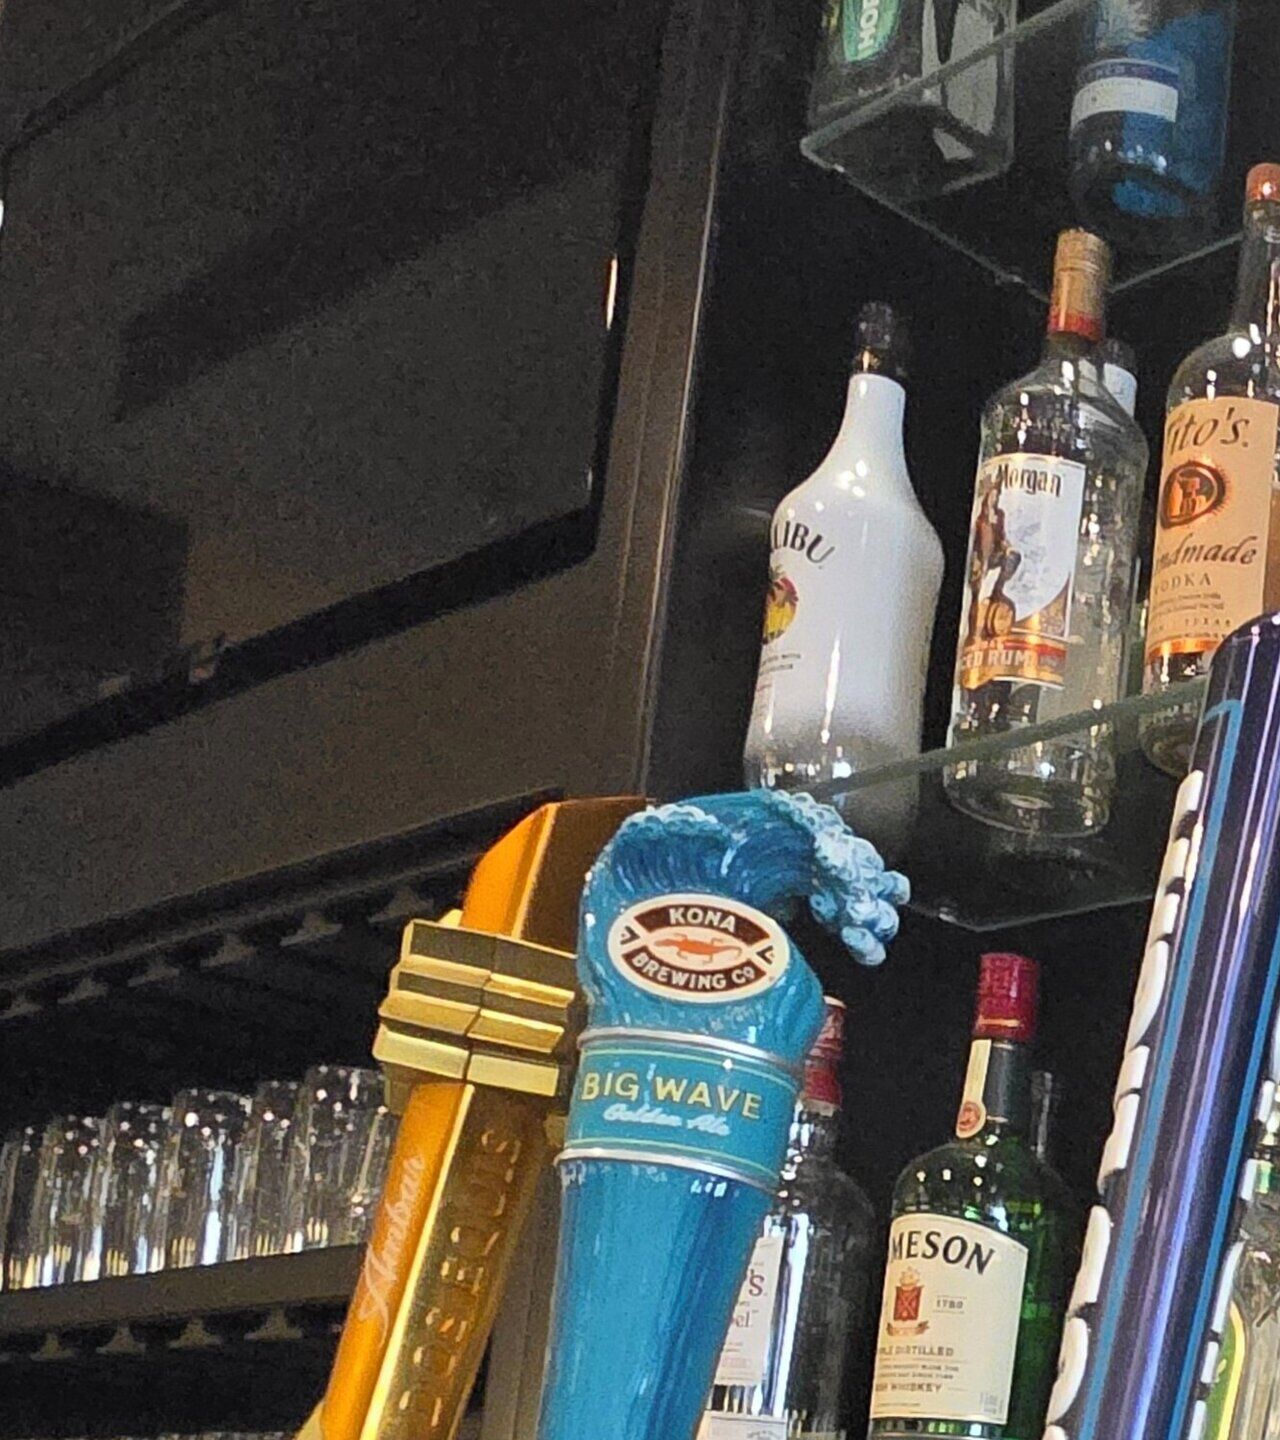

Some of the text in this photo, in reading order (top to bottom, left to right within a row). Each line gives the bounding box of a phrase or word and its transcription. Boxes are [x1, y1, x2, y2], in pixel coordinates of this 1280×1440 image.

[771, 519, 836, 564] LIBU
[668, 907, 738, 935] KONA
[630, 951, 728, 990] BREWING
[581, 1071, 763, 1120] BIG WAVE
[603, 1102, 683, 1127] Golden
